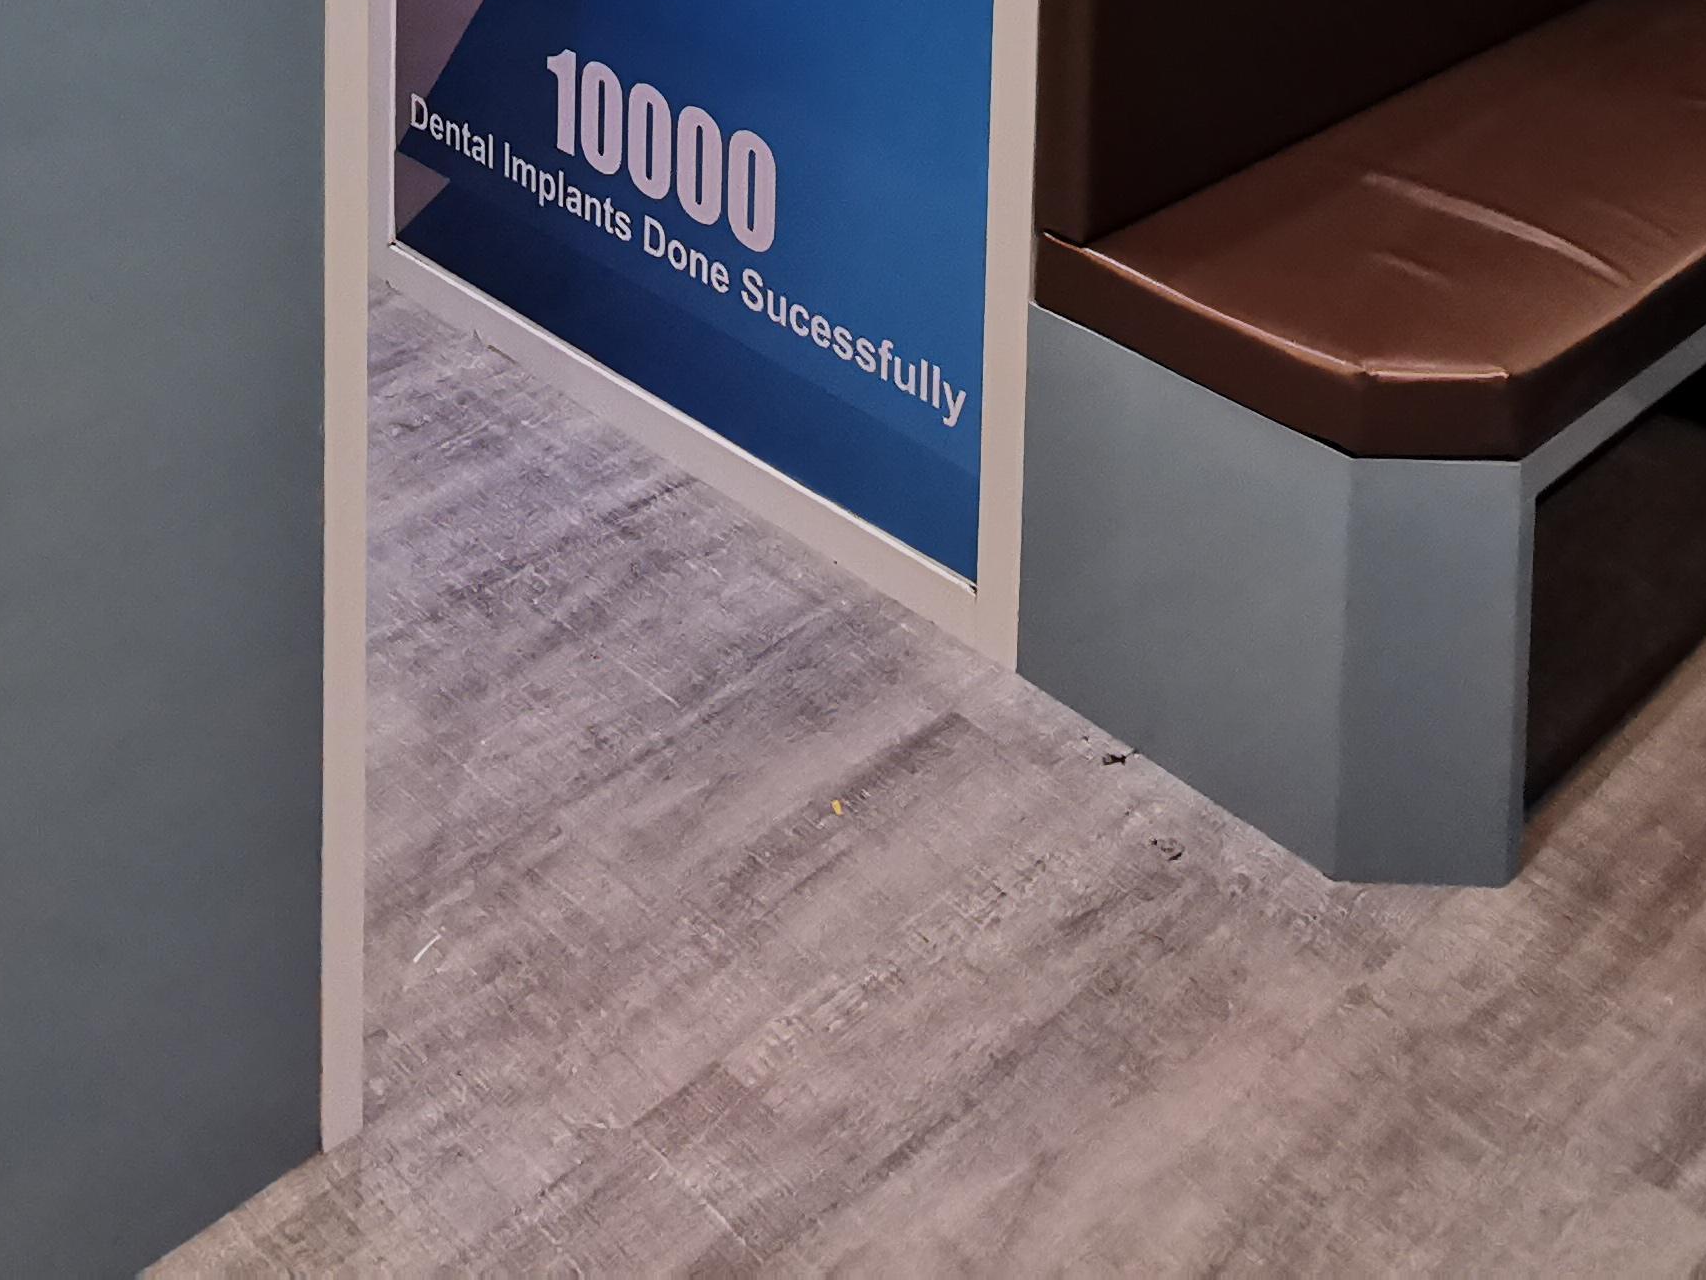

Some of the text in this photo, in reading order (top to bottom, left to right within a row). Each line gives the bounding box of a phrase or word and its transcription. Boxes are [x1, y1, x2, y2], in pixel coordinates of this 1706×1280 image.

[410, 92, 967, 428] Dental Implants Done Sucessfully
[546, 48, 777, 253] 10000
